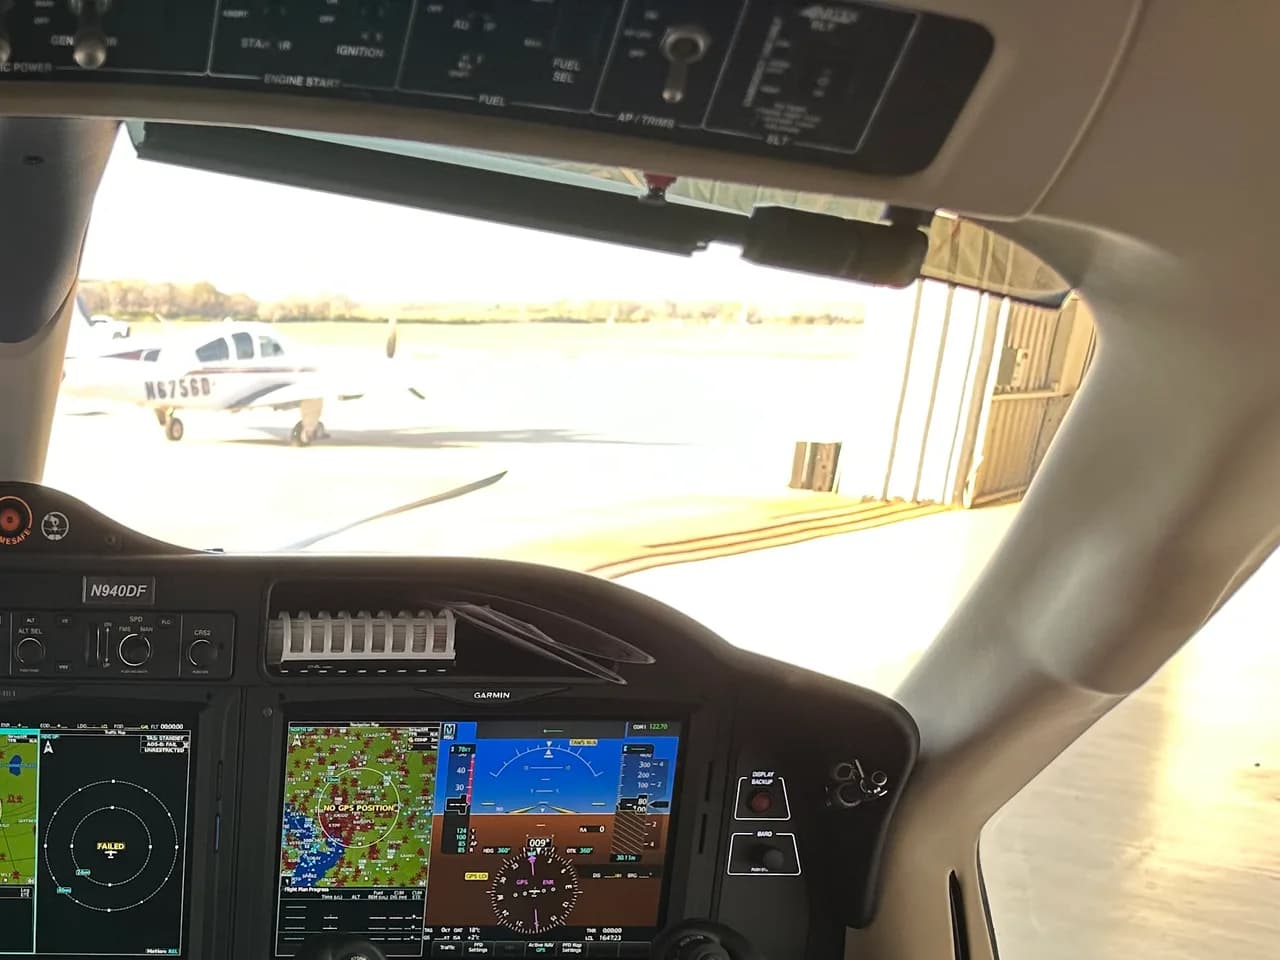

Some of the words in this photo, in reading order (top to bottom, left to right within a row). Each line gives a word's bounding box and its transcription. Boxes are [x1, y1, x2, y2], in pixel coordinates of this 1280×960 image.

[336, 45, 384, 58] IGNITION
[479, 94, 506, 107] FUEL
[90, 583, 148, 598] N940DF
[474, 691, 511, 699] GARMIN
